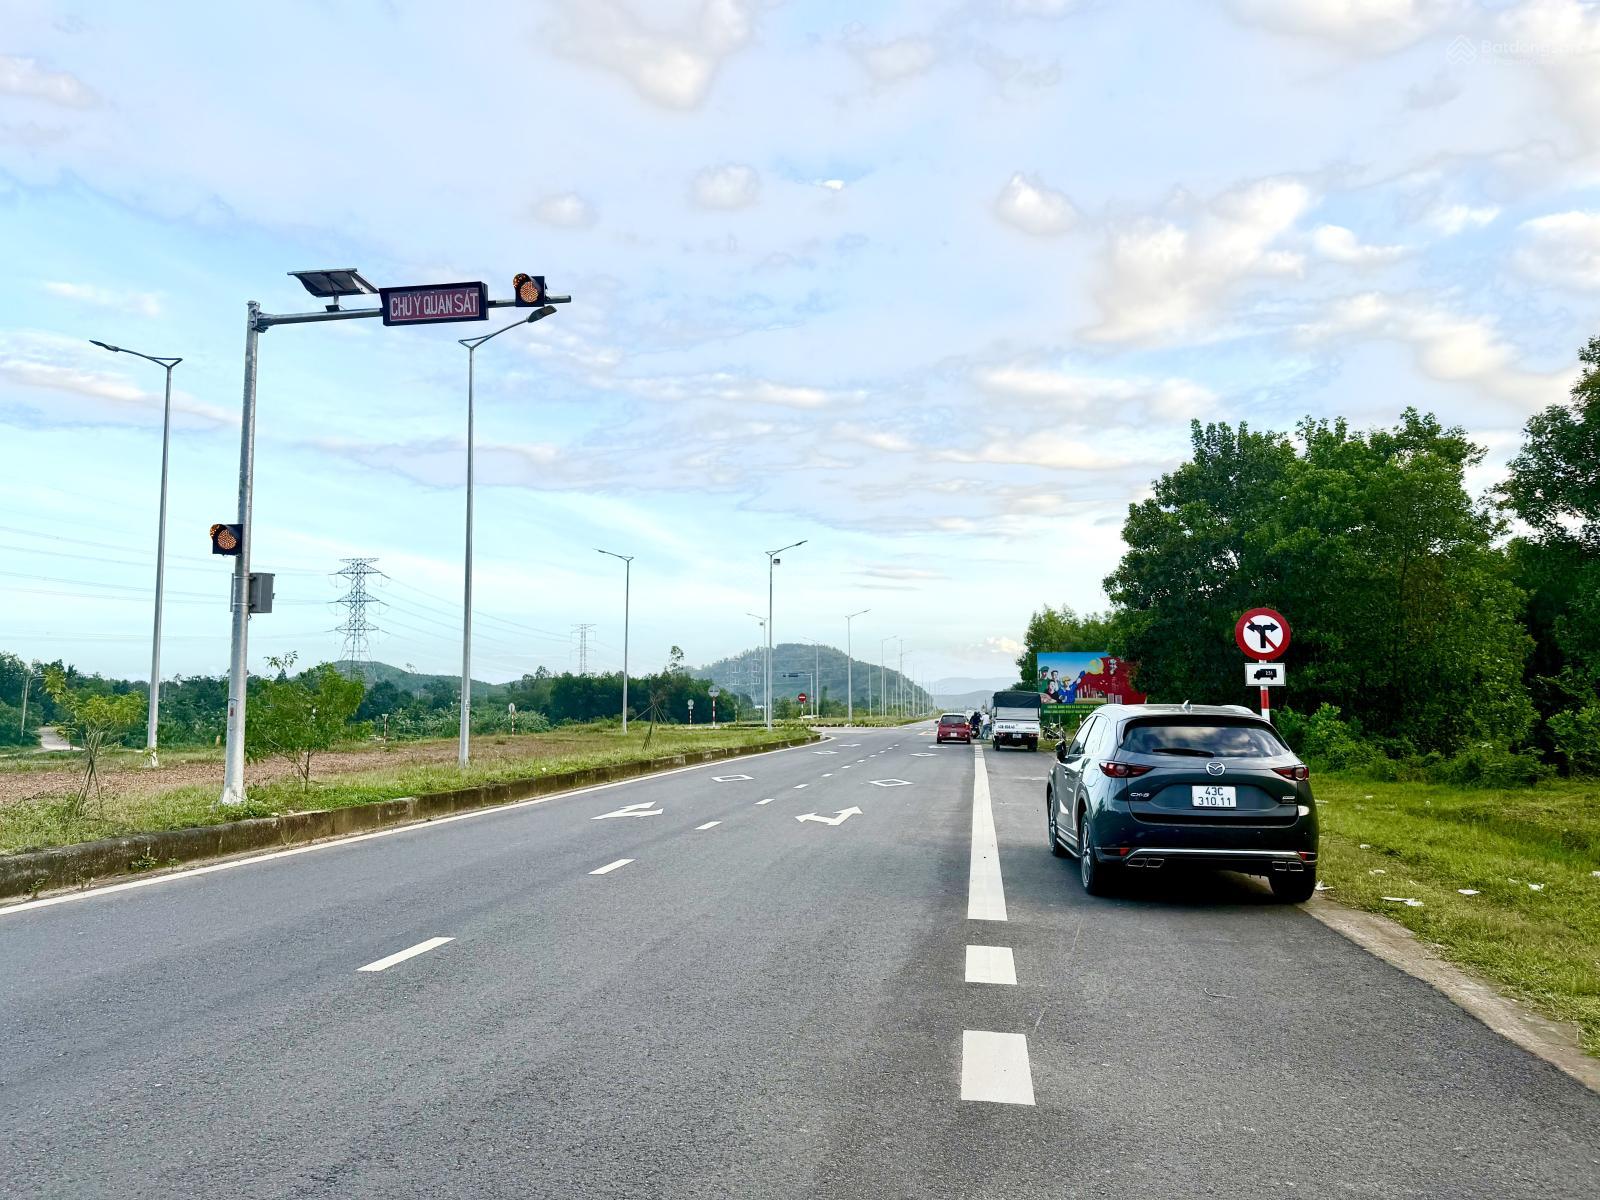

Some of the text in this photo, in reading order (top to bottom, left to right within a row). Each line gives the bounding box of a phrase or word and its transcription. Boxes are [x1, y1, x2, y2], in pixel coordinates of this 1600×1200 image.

[391, 289, 479, 317] CHÚ Ý QUAN SÁT
[1204, 787, 1224, 796] 43C
[1197, 797, 1231, 807] 310.11
